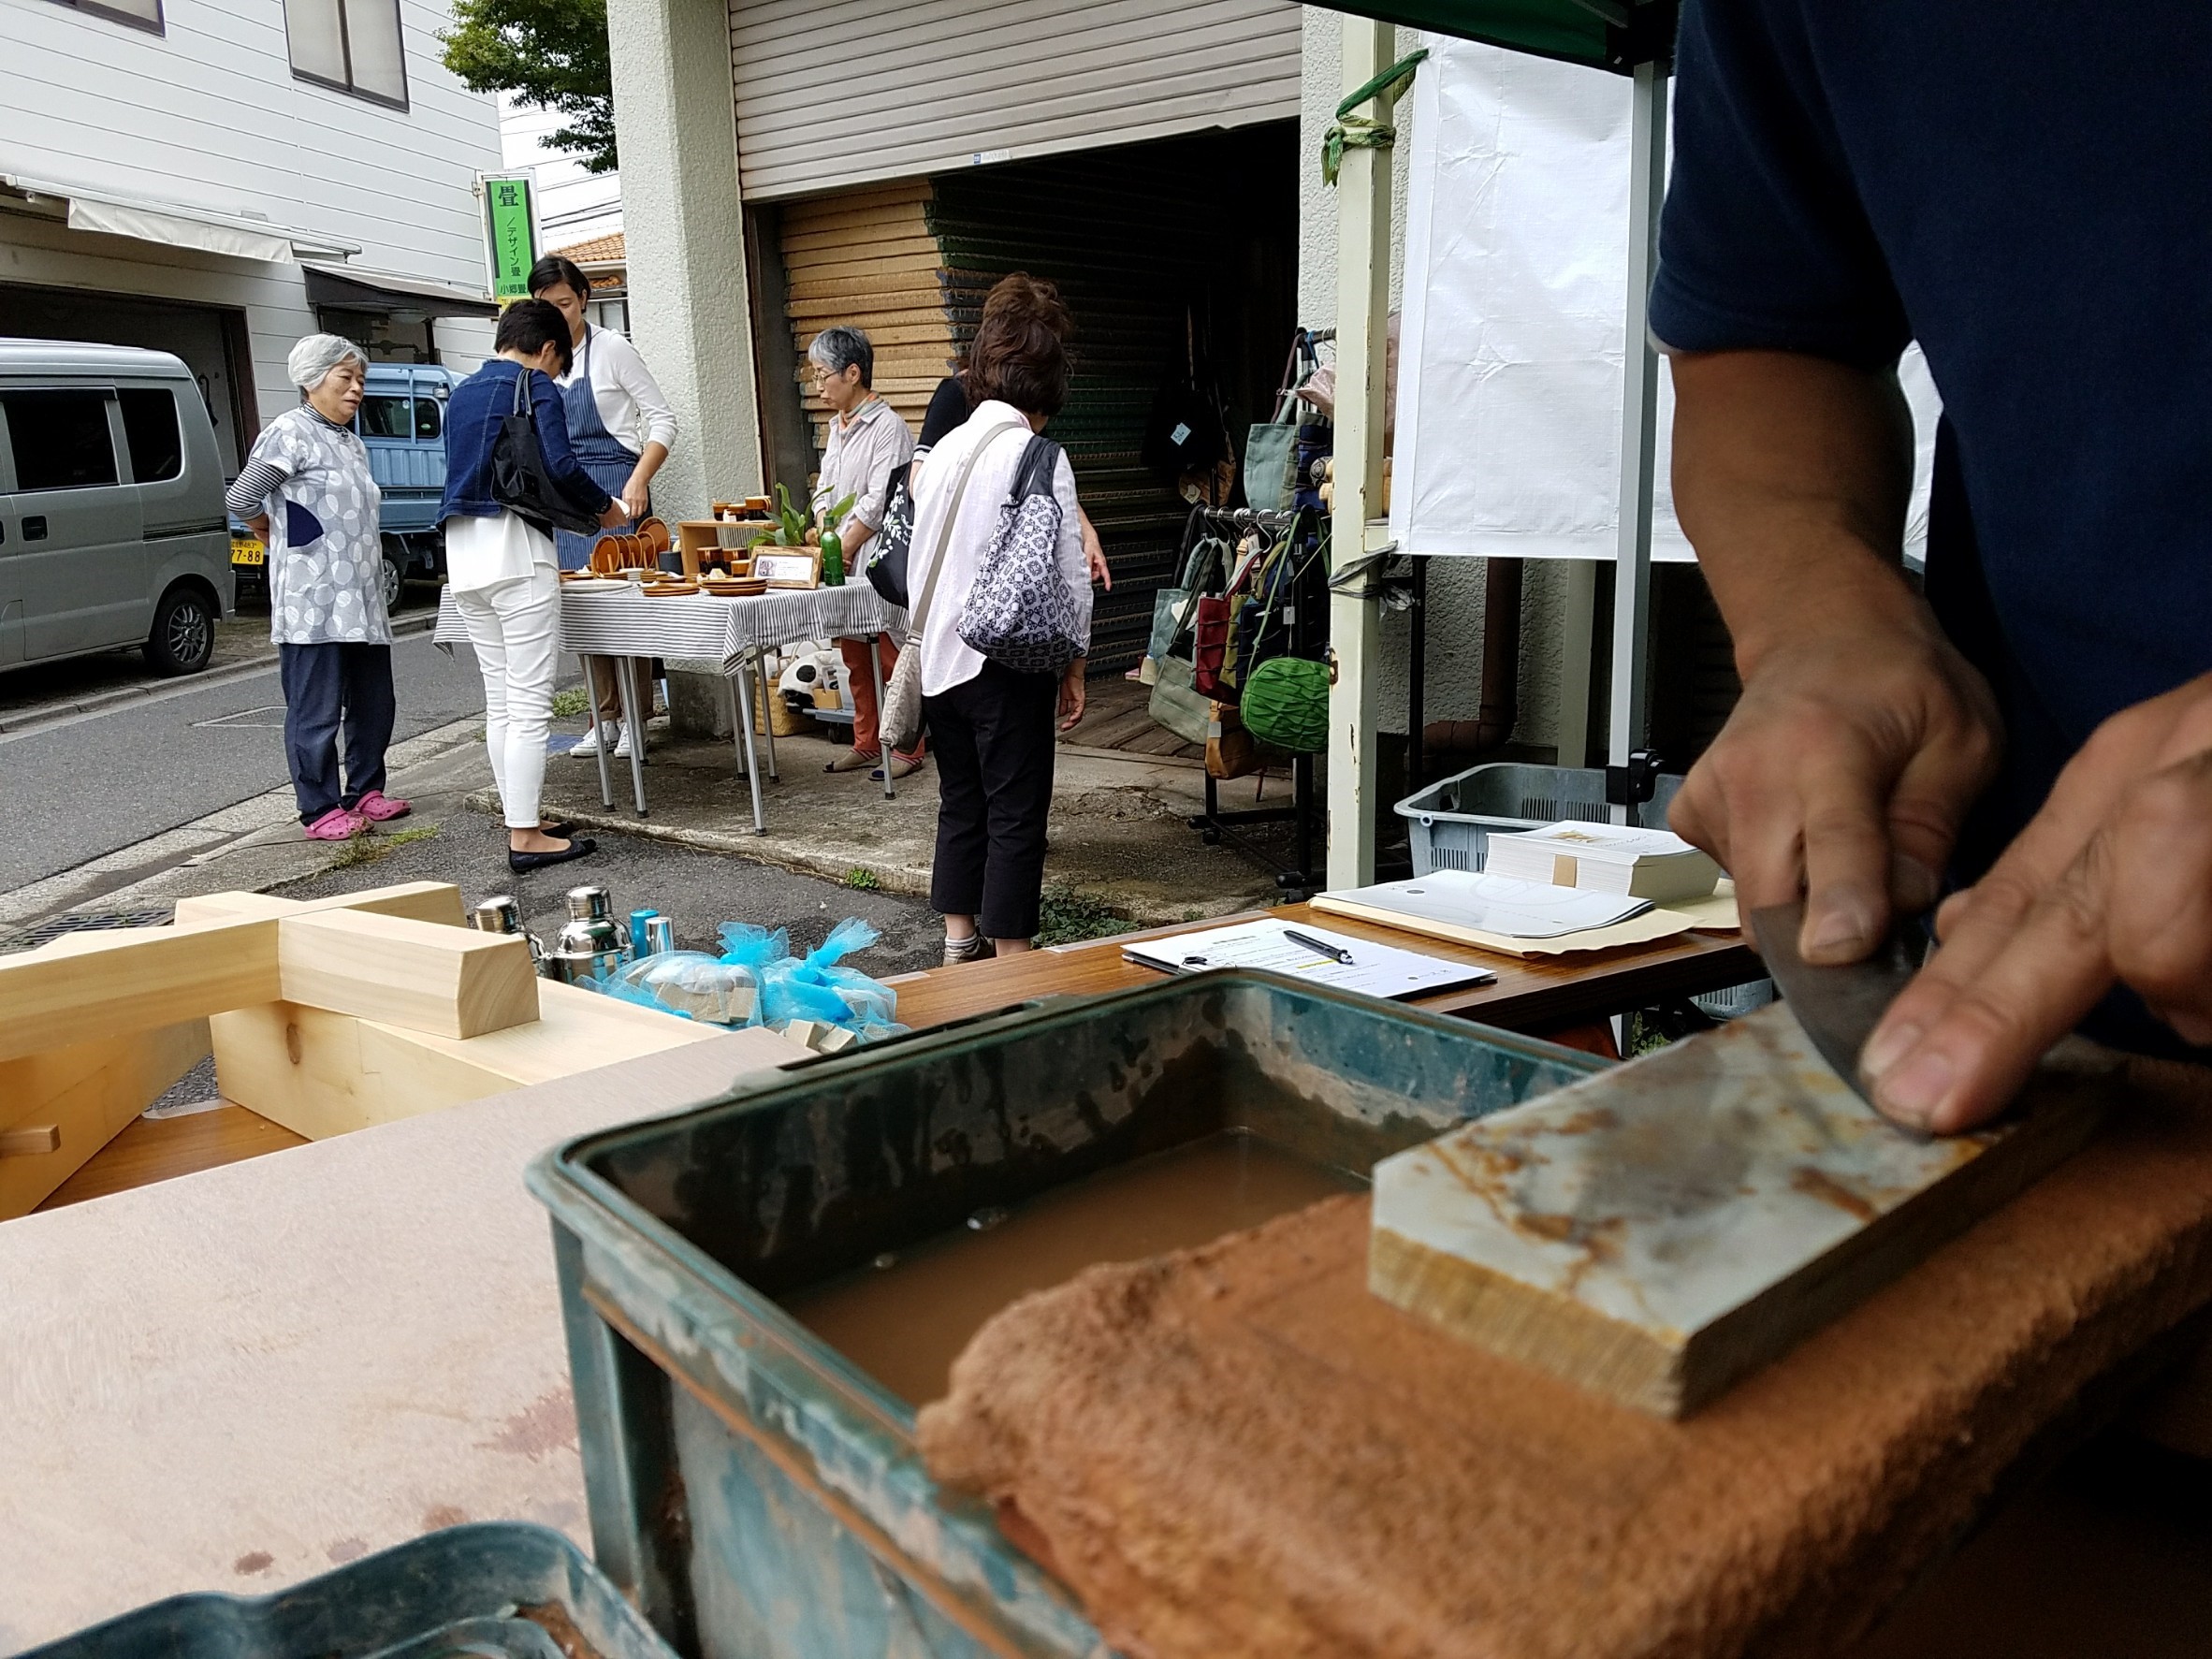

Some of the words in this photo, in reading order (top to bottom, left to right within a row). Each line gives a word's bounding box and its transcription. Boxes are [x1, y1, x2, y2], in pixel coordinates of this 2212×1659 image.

[498, 185, 519, 208] 畳
[500, 284, 529, 295] 小郷畳
